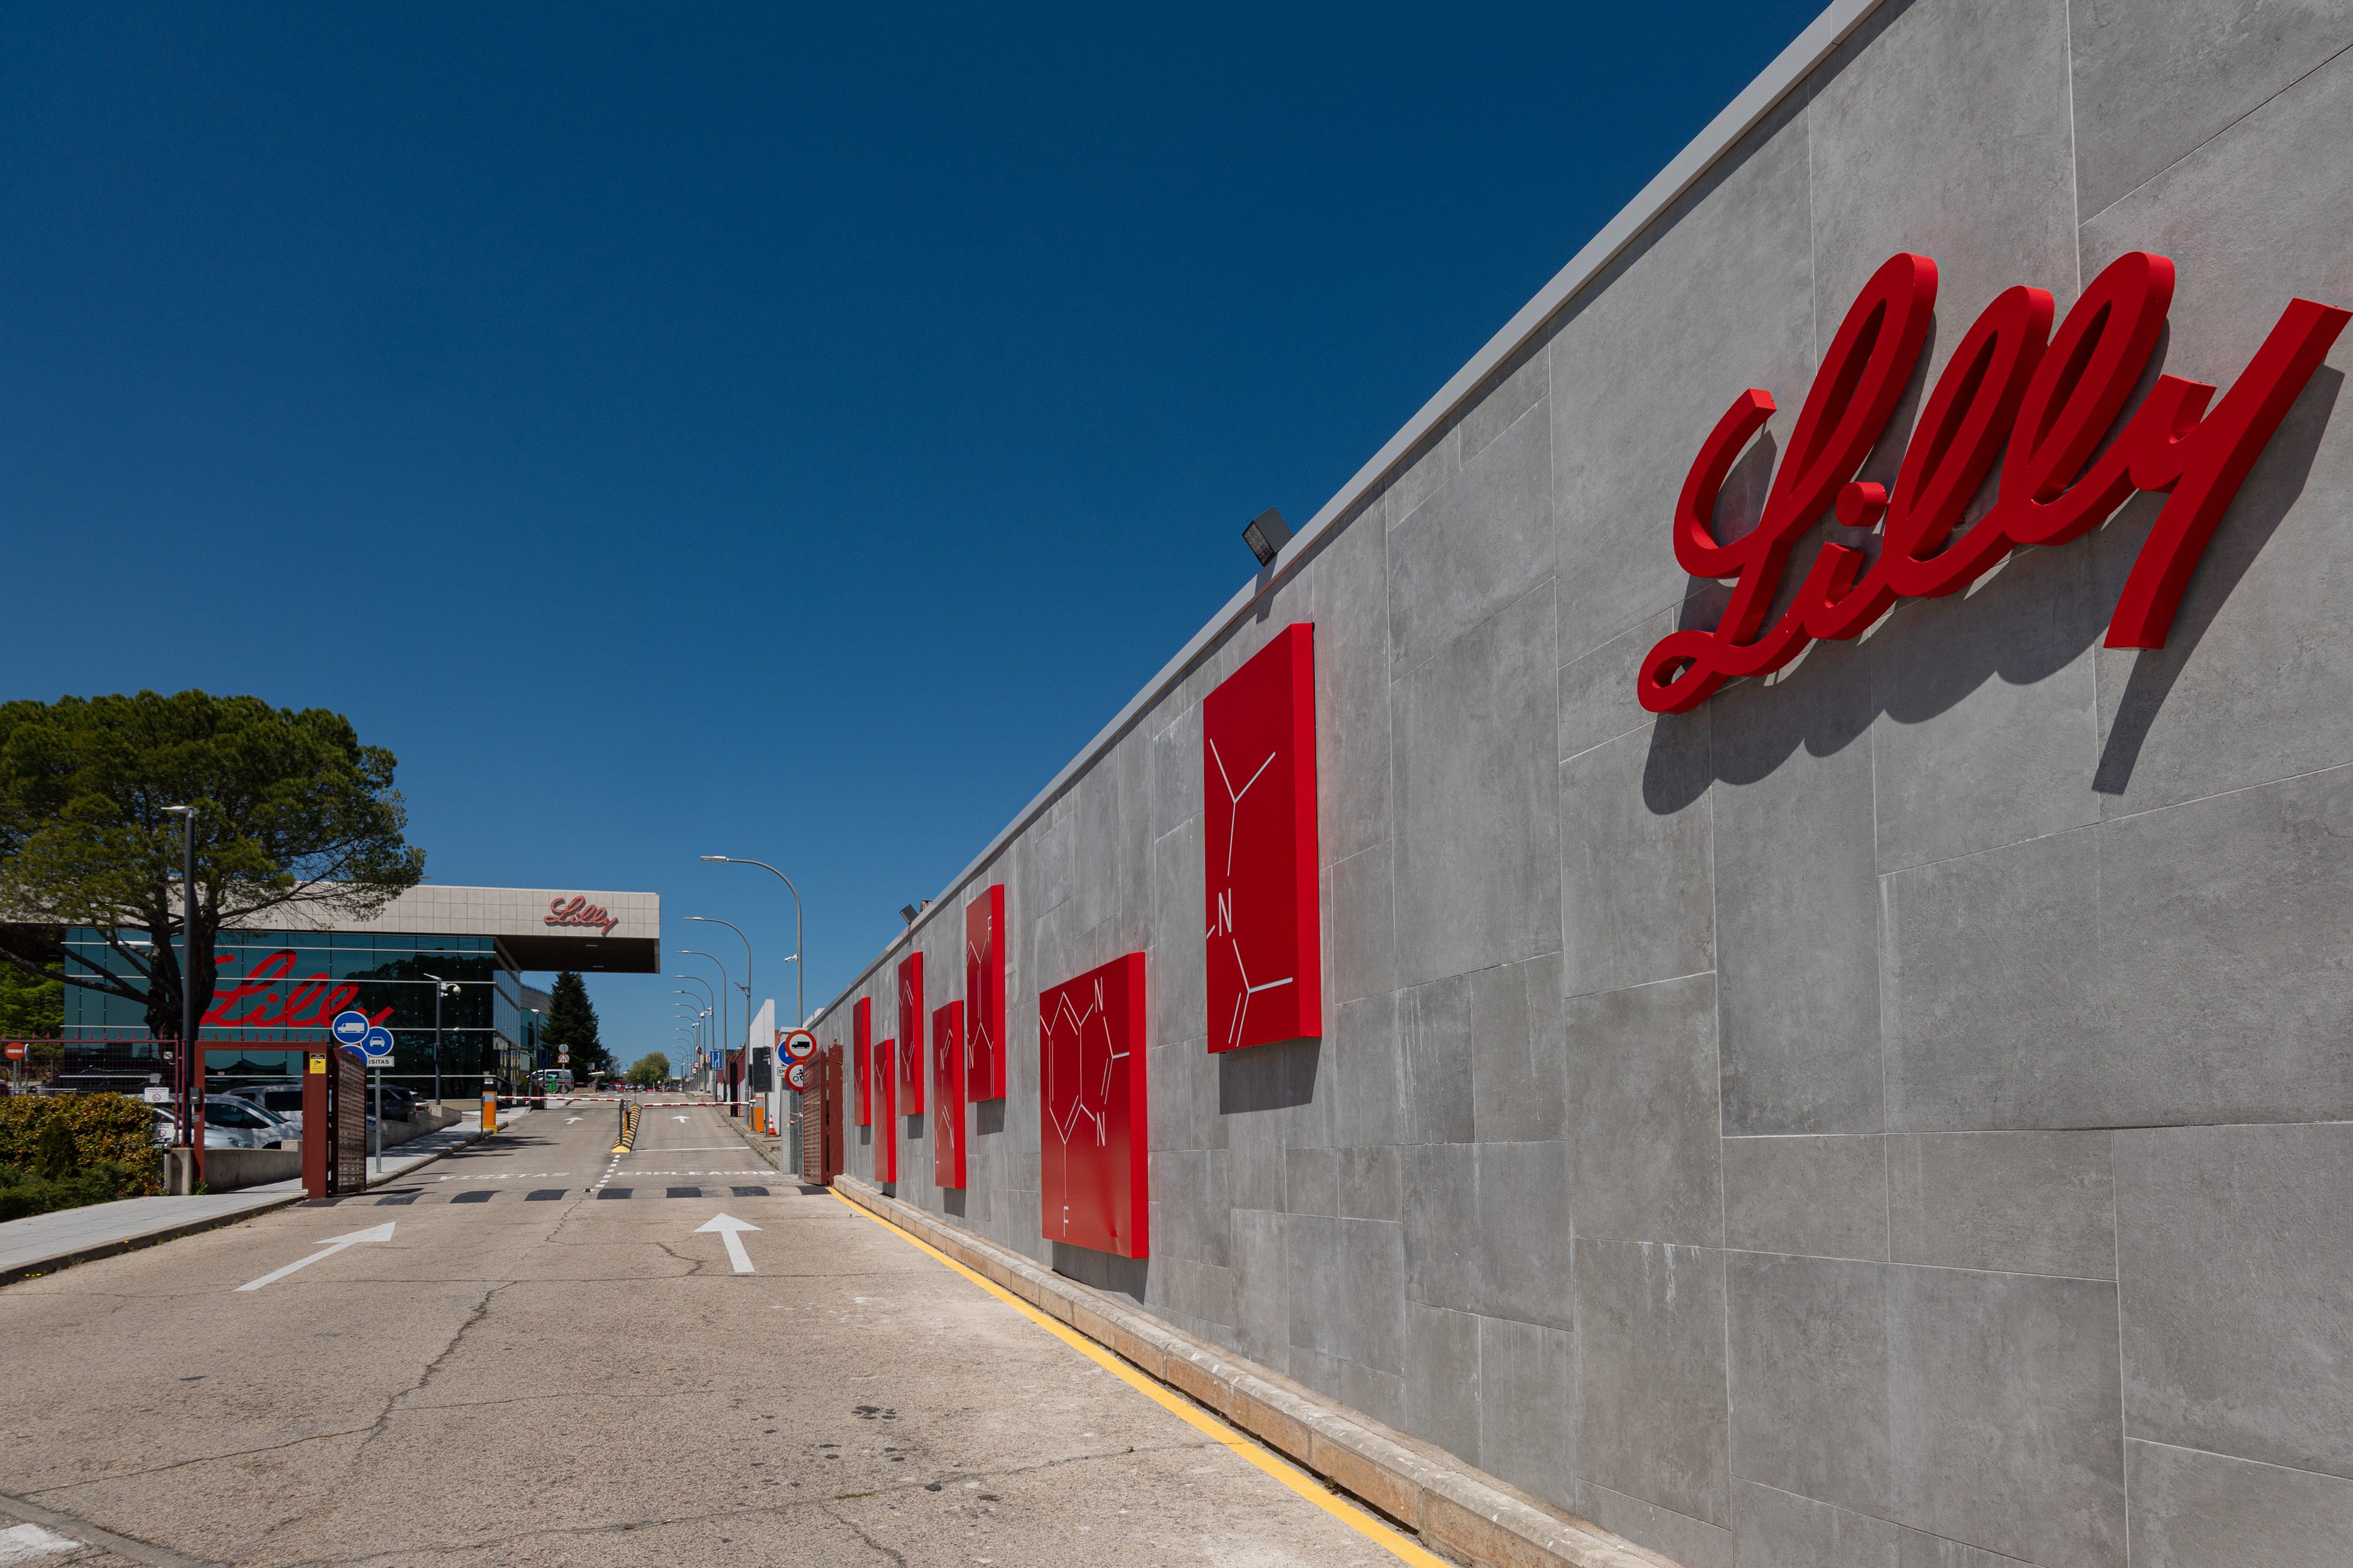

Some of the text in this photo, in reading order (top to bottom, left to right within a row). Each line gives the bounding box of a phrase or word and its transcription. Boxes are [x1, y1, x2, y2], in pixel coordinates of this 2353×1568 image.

[1637, 252, 2353, 715] Lilly
[544, 895, 618, 934] Lilly
[1218, 888, 1232, 936] N
[1095, 976, 1104, 1013] N
[969, 1044, 974, 1069] N
[1097, 1111, 1105, 1146] N
[1063, 1206, 1069, 1237] F
